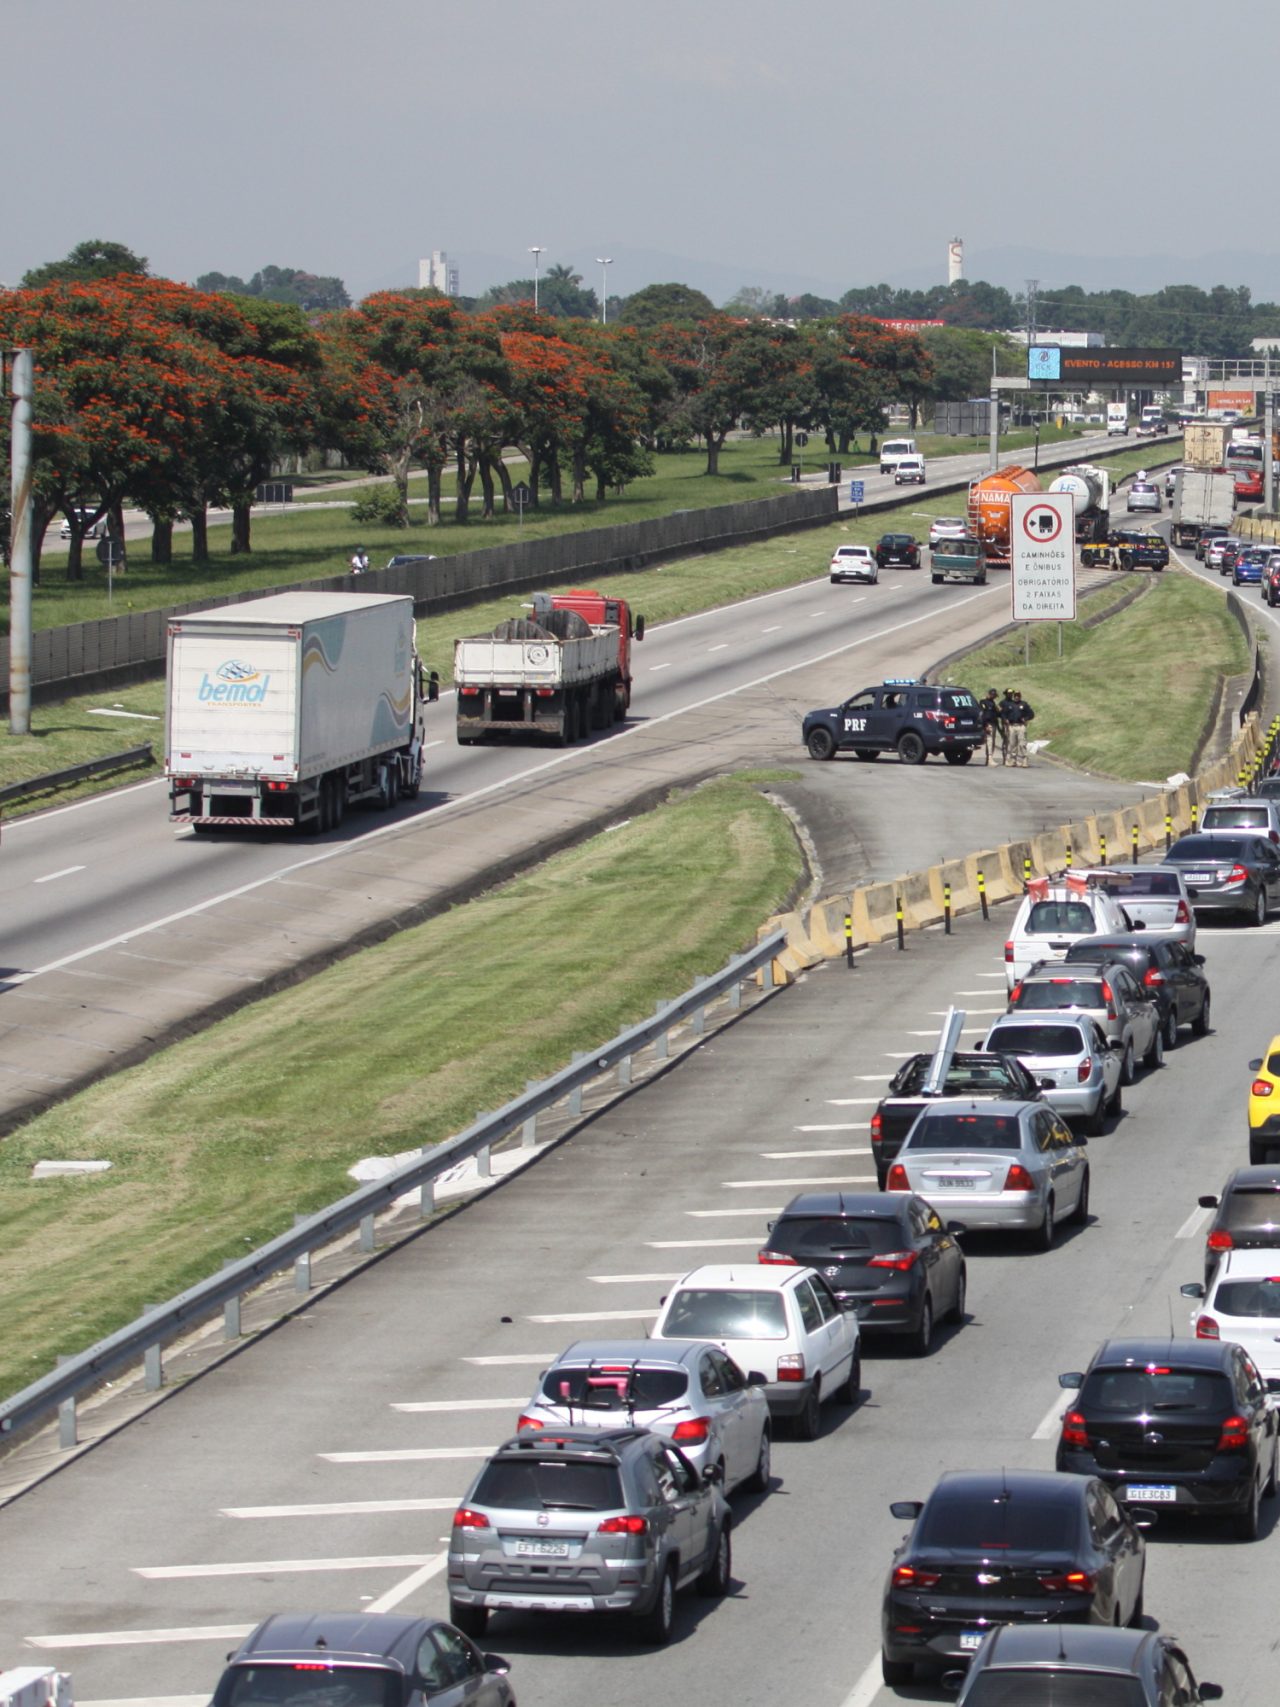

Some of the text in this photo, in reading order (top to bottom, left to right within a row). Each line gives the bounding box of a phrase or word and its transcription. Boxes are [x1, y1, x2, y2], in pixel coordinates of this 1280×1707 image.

[1064, 360, 1100, 368] EVENTO
[1107, 360, 1142, 368] ACESSO
[1021, 551, 1065, 559] CAMINHÕES
[1033, 562, 1061, 571] ÔNIBUS
[1018, 577, 1070, 586] OBRIGATÓRIO
[198, 673, 271, 703] bemol
[951, 695, 972, 708] PRF
[844, 718, 867, 732] PRF
